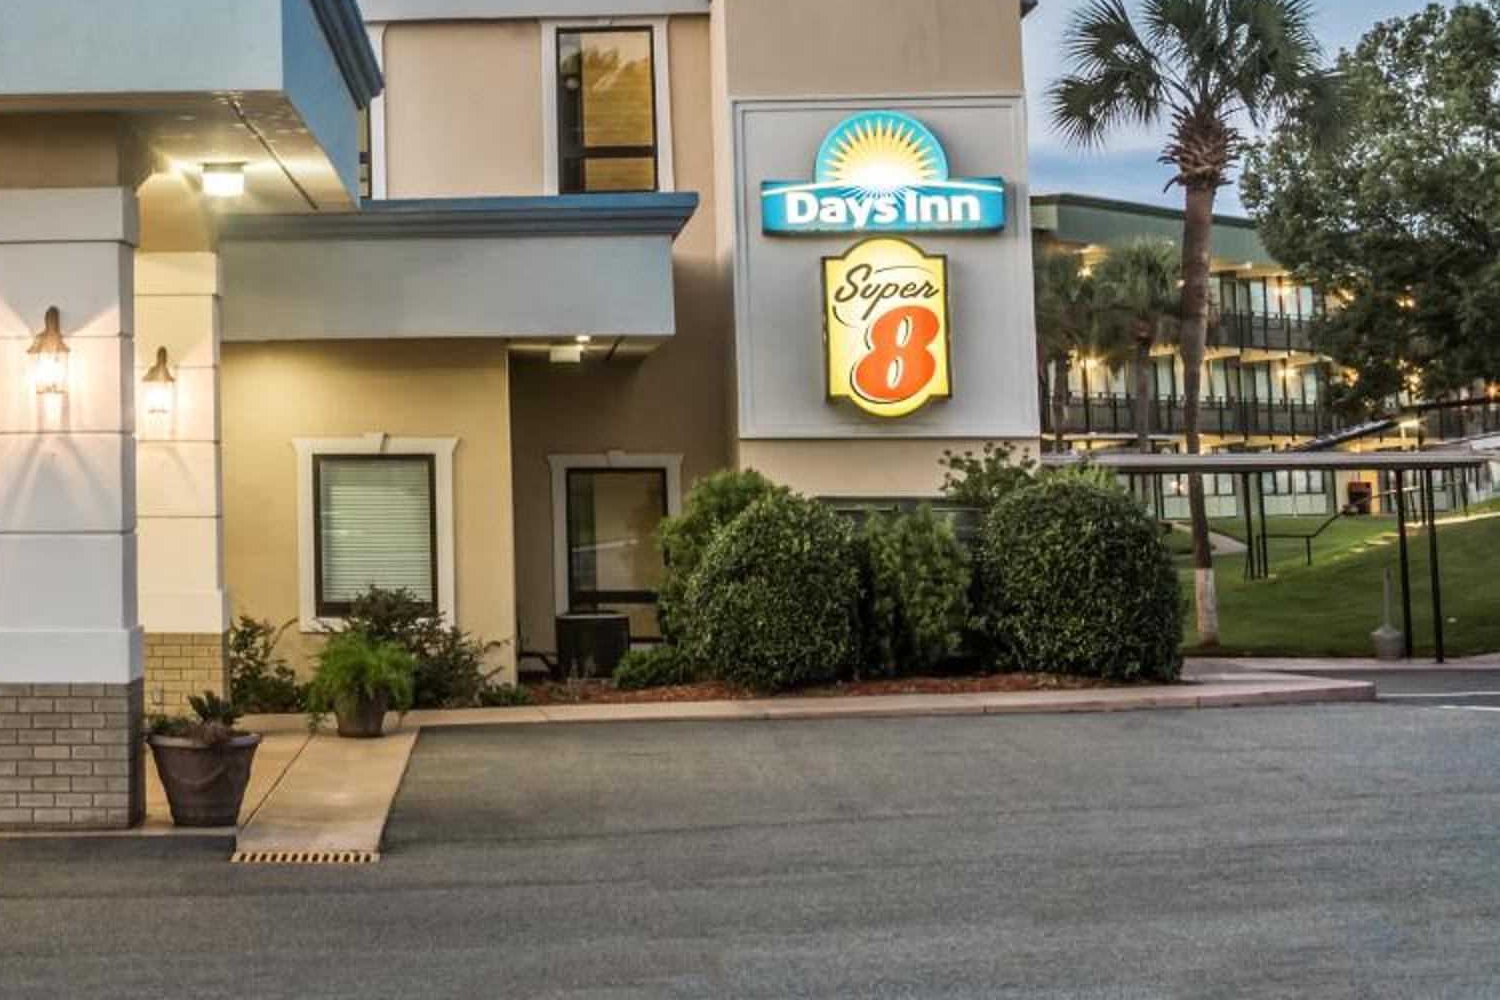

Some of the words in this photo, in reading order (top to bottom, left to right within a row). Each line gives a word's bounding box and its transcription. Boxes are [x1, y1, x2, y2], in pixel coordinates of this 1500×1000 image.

[785, 191, 899, 229] Days
[904, 190, 981, 222] Inn
[834, 263, 940, 320] Super
[855, 305, 940, 402] 8
